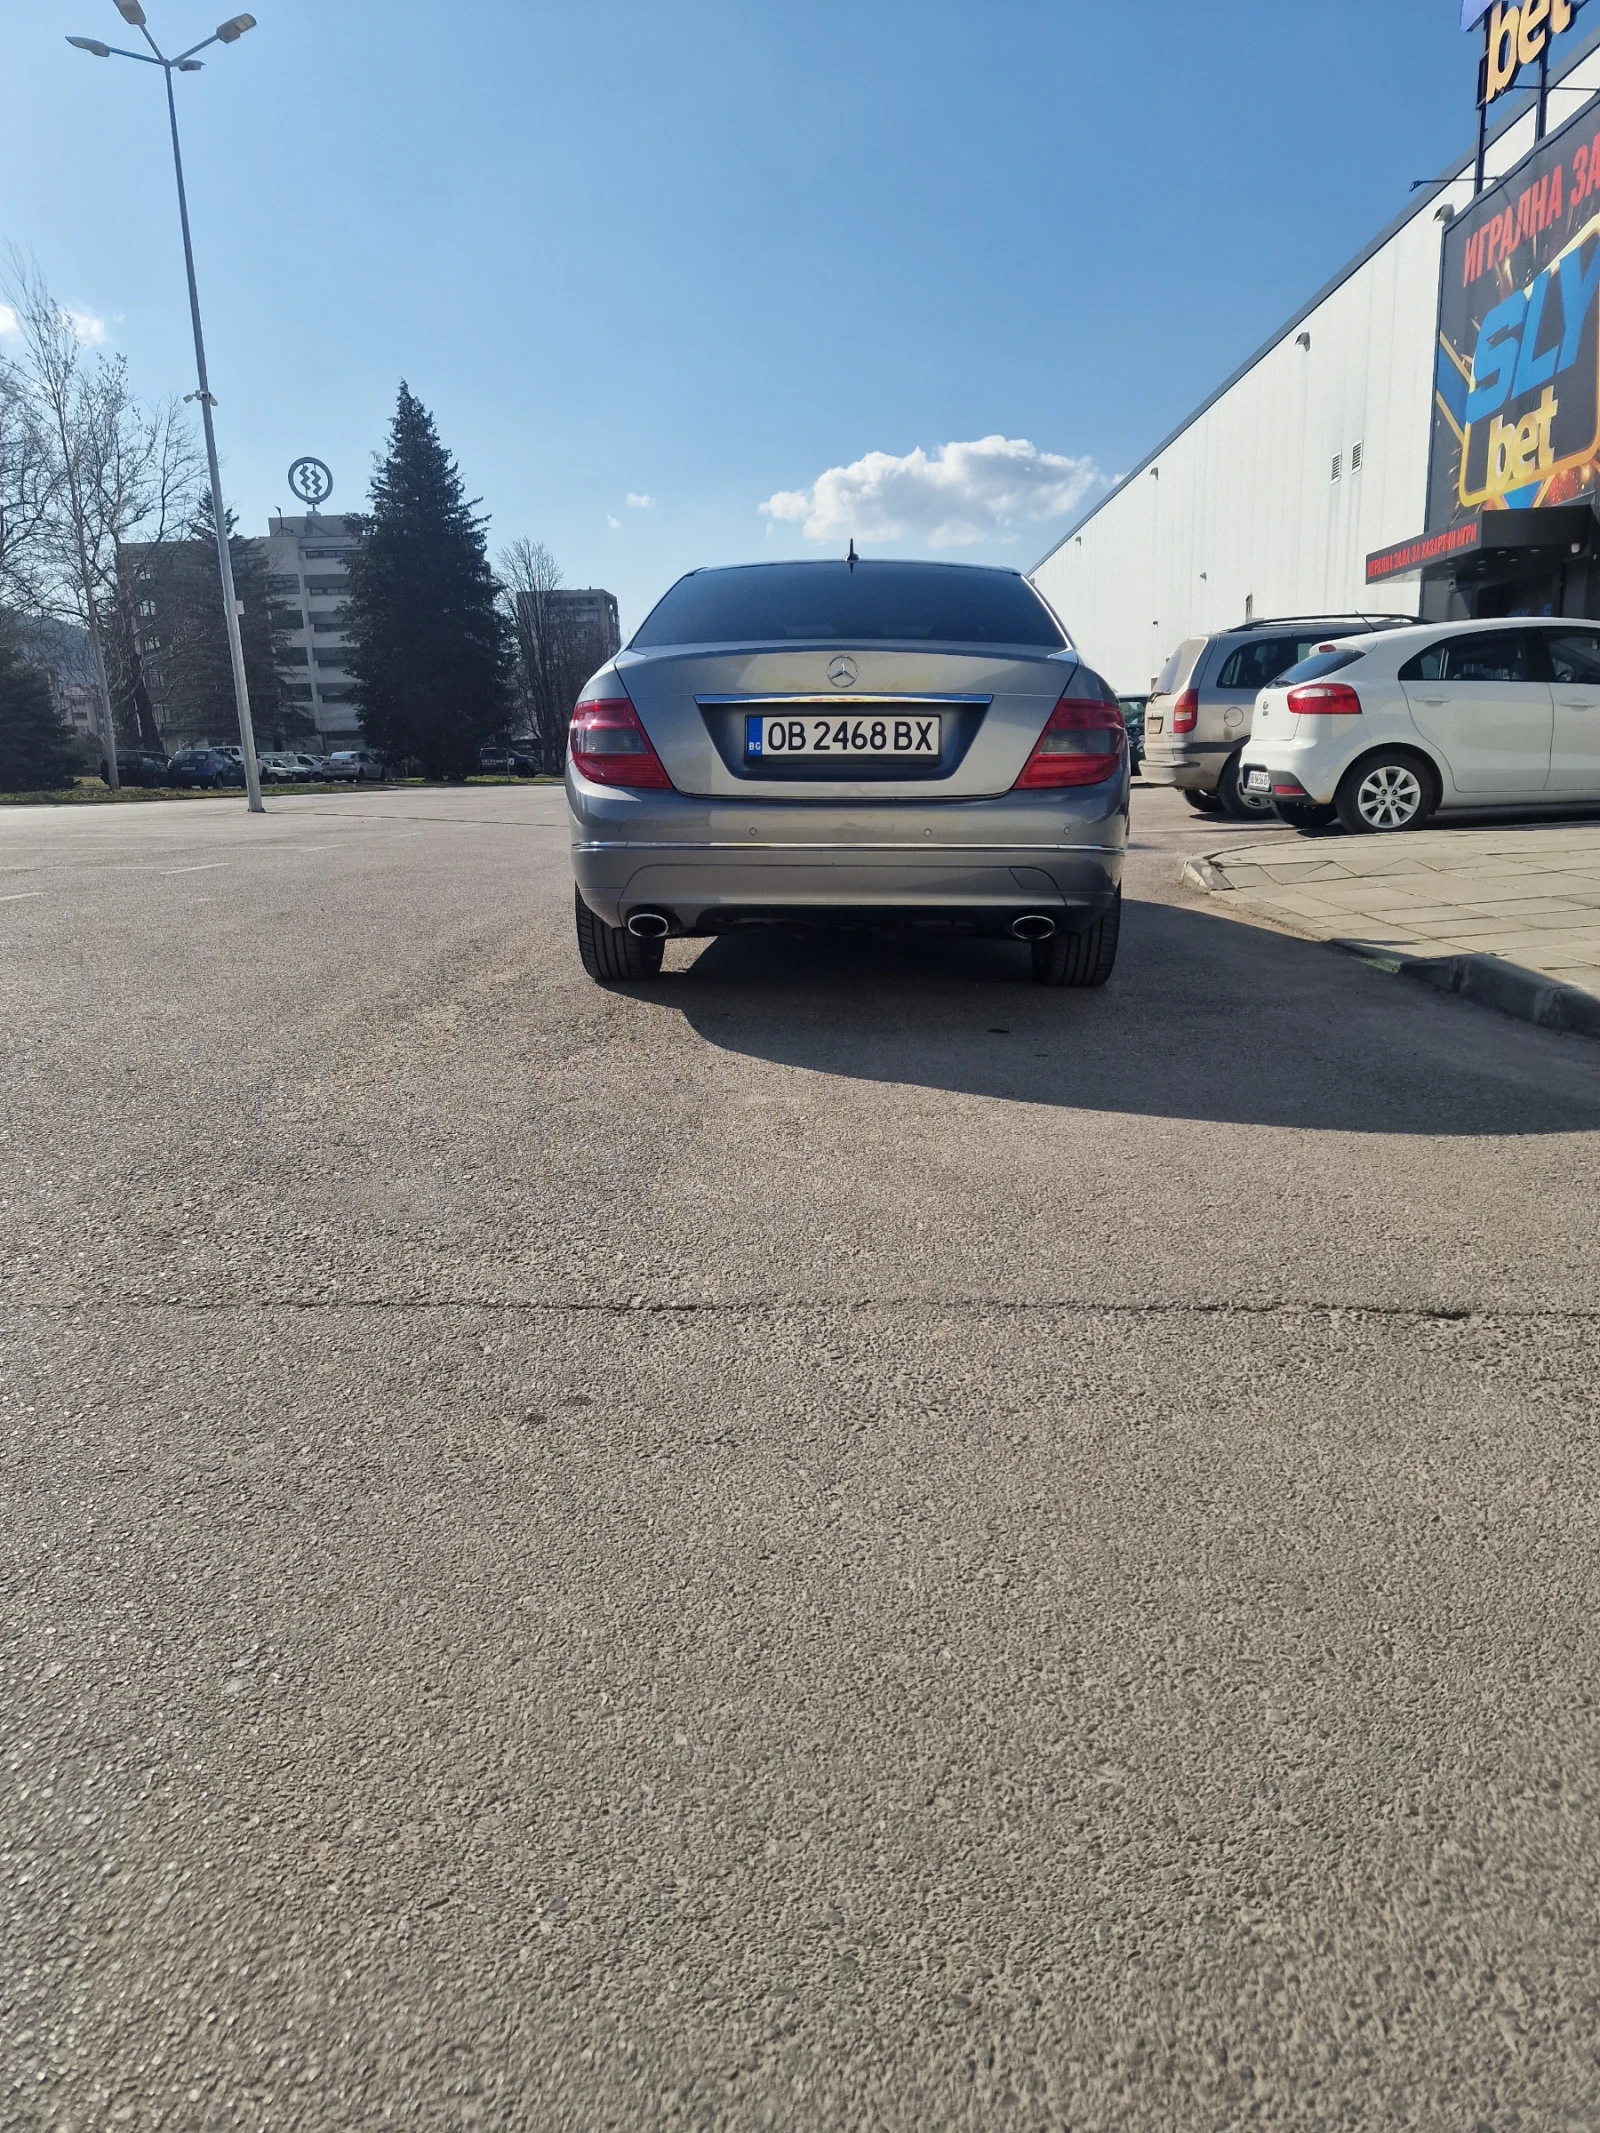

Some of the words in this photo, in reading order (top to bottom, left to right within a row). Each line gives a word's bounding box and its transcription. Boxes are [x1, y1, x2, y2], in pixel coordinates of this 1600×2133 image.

[1463, 164, 1562, 289] ИГРАЛНА
[1465, 240, 1600, 424] SLY
[1485, 385, 1559, 493] bet
[1367, 554, 1393, 578] ИГРАЛНА
[1393, 547, 1410, 570] ЗАЛА
[1411, 543, 1420, 563] ЗА
[1457, 522, 1477, 547] ИГРИ
[748, 741, 761, 751] BG
[768, 721, 806, 751] OB
[813, 721, 887, 751] 2468
[894, 721, 933, 751] BX
